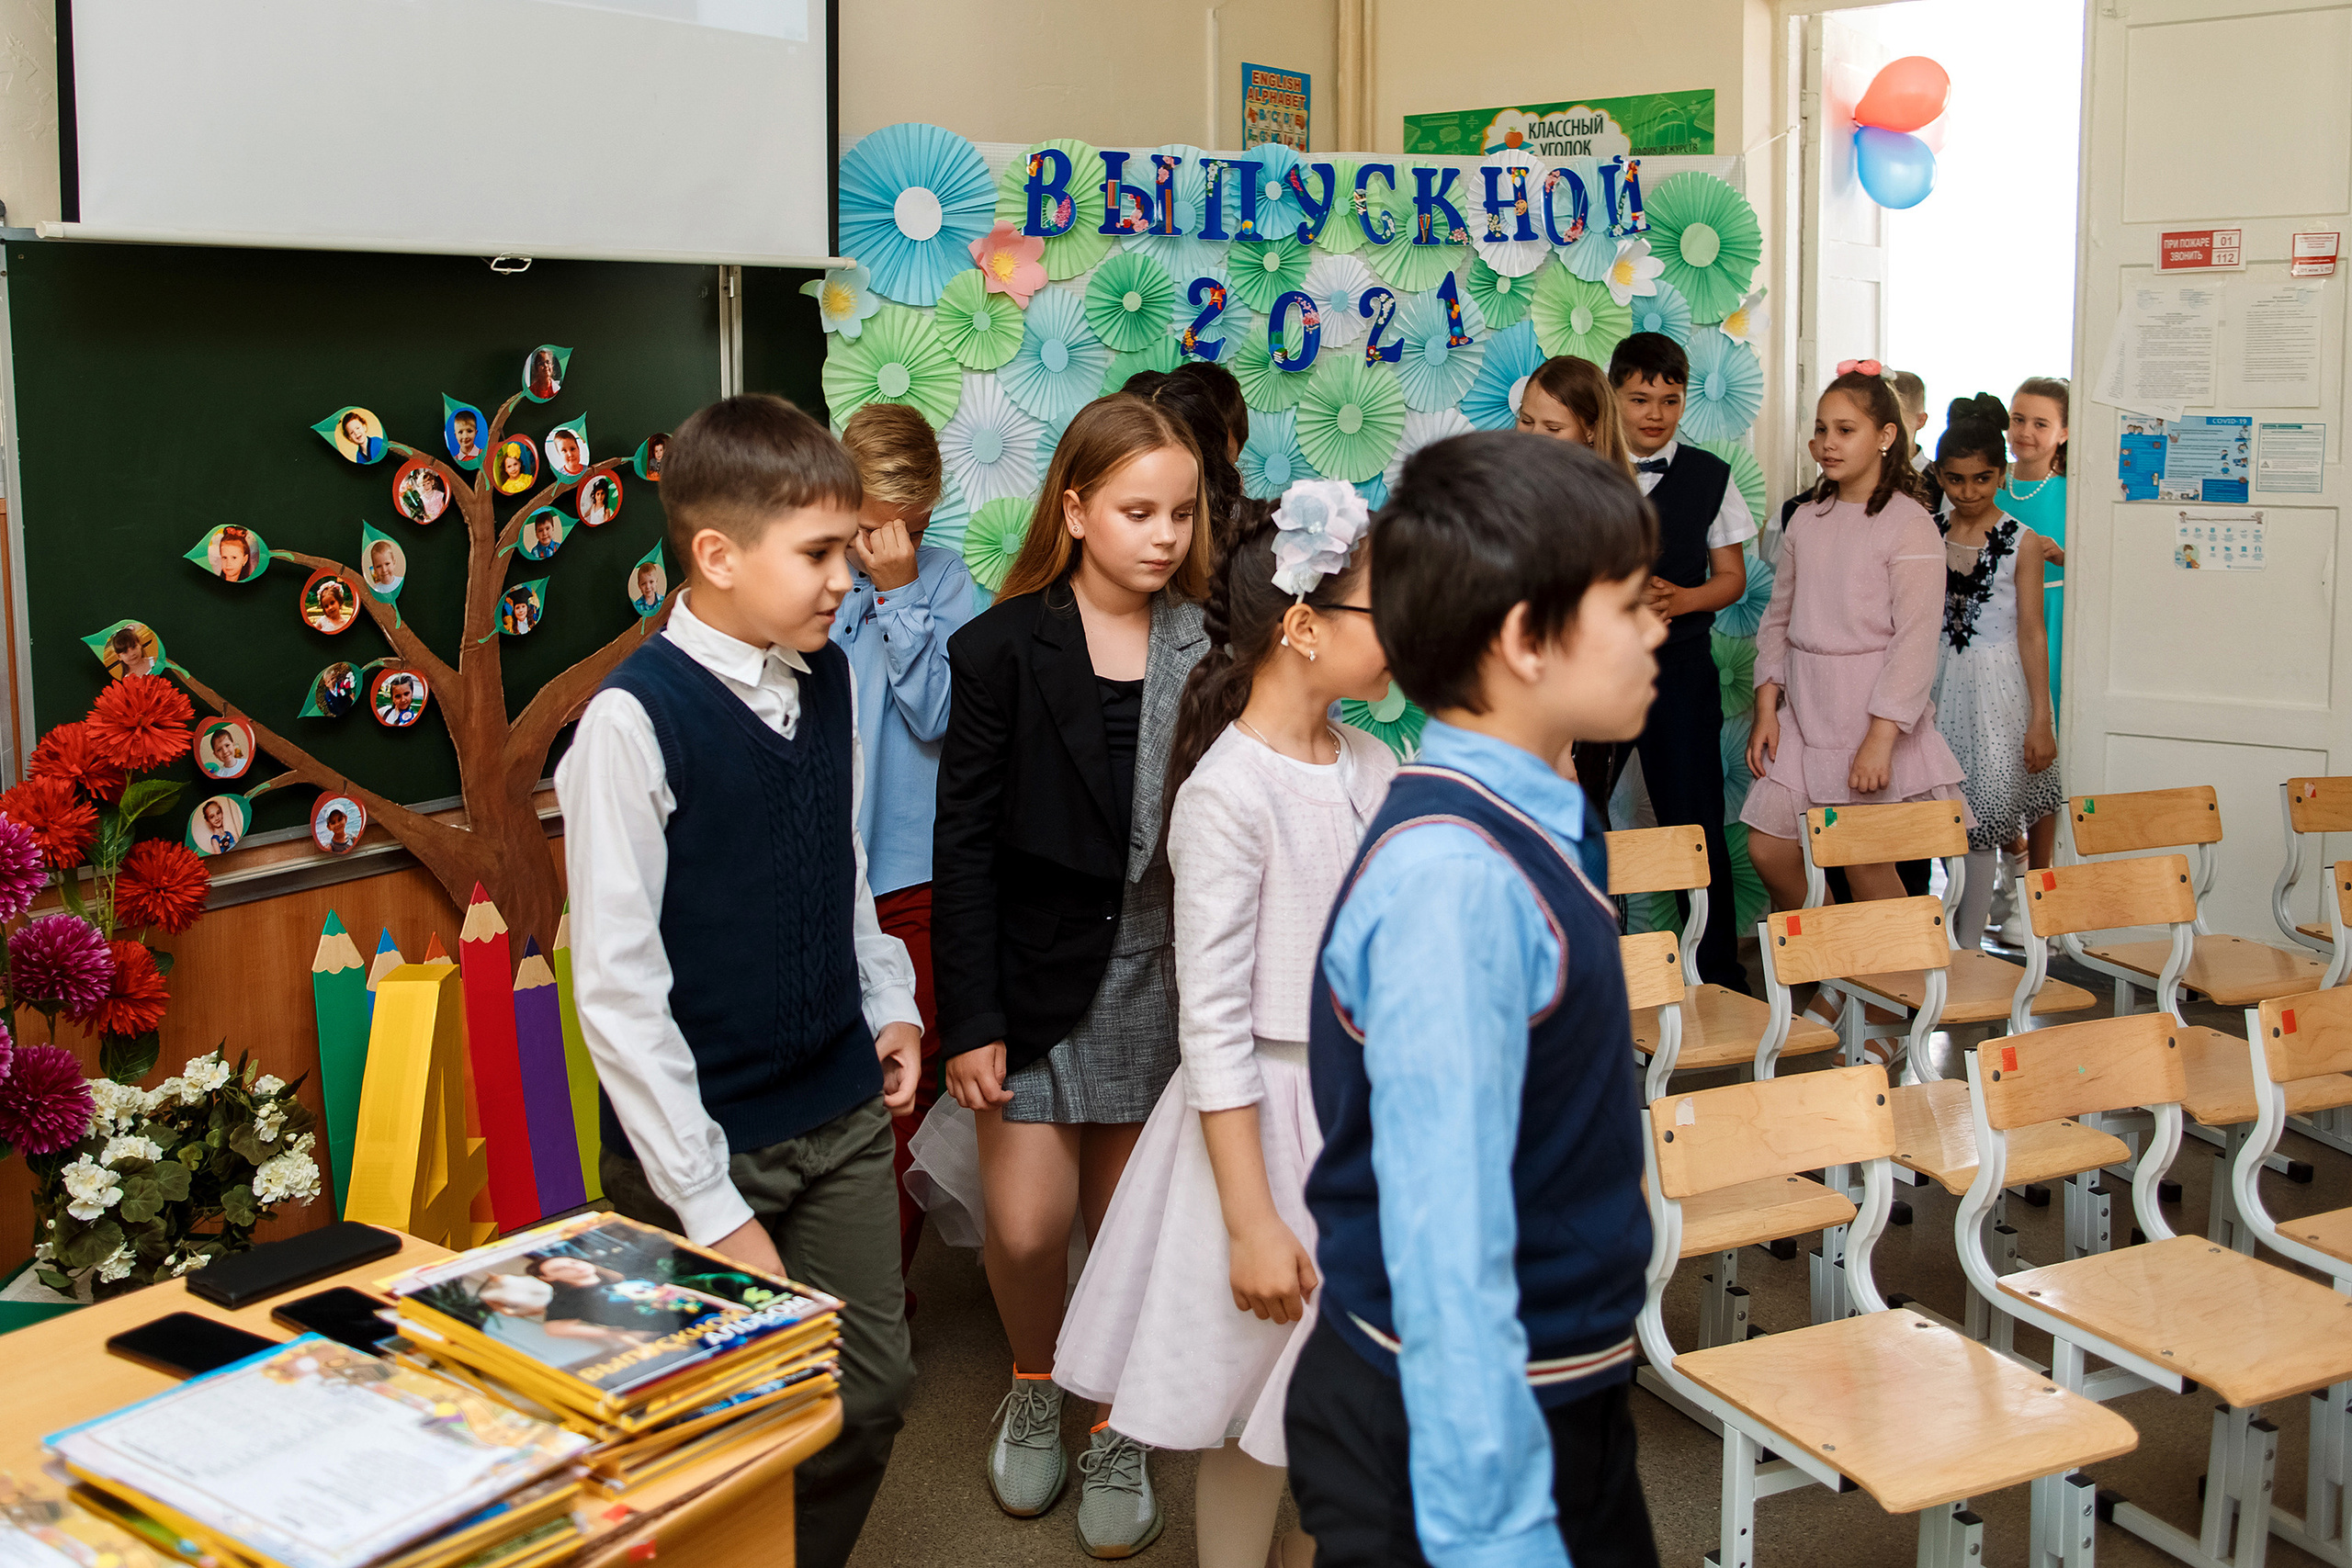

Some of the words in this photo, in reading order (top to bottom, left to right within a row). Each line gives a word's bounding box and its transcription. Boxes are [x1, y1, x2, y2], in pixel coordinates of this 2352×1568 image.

[1252, 70, 1302, 93] ENGLISH
[1247, 86, 1306, 109] ALPHABET
[1529, 115, 1603, 139] КЛАССНЫЙ
[1540, 140, 1591, 155] УГОЛОК
[1023, 148, 1652, 246] ВЫПУСКНОЙ
[2164, 239, 2178, 249] ПРИ
[2179, 237, 2211, 248] ПОЖАРЕ
[2221, 236, 2233, 246] 01
[2169, 251, 2203, 262] ЗВОНИТЬ
[2216, 254, 2234, 263] 112
[1181, 270, 1474, 373] 2021
[703, 1295, 816, 1346] АЛЬБОМ
